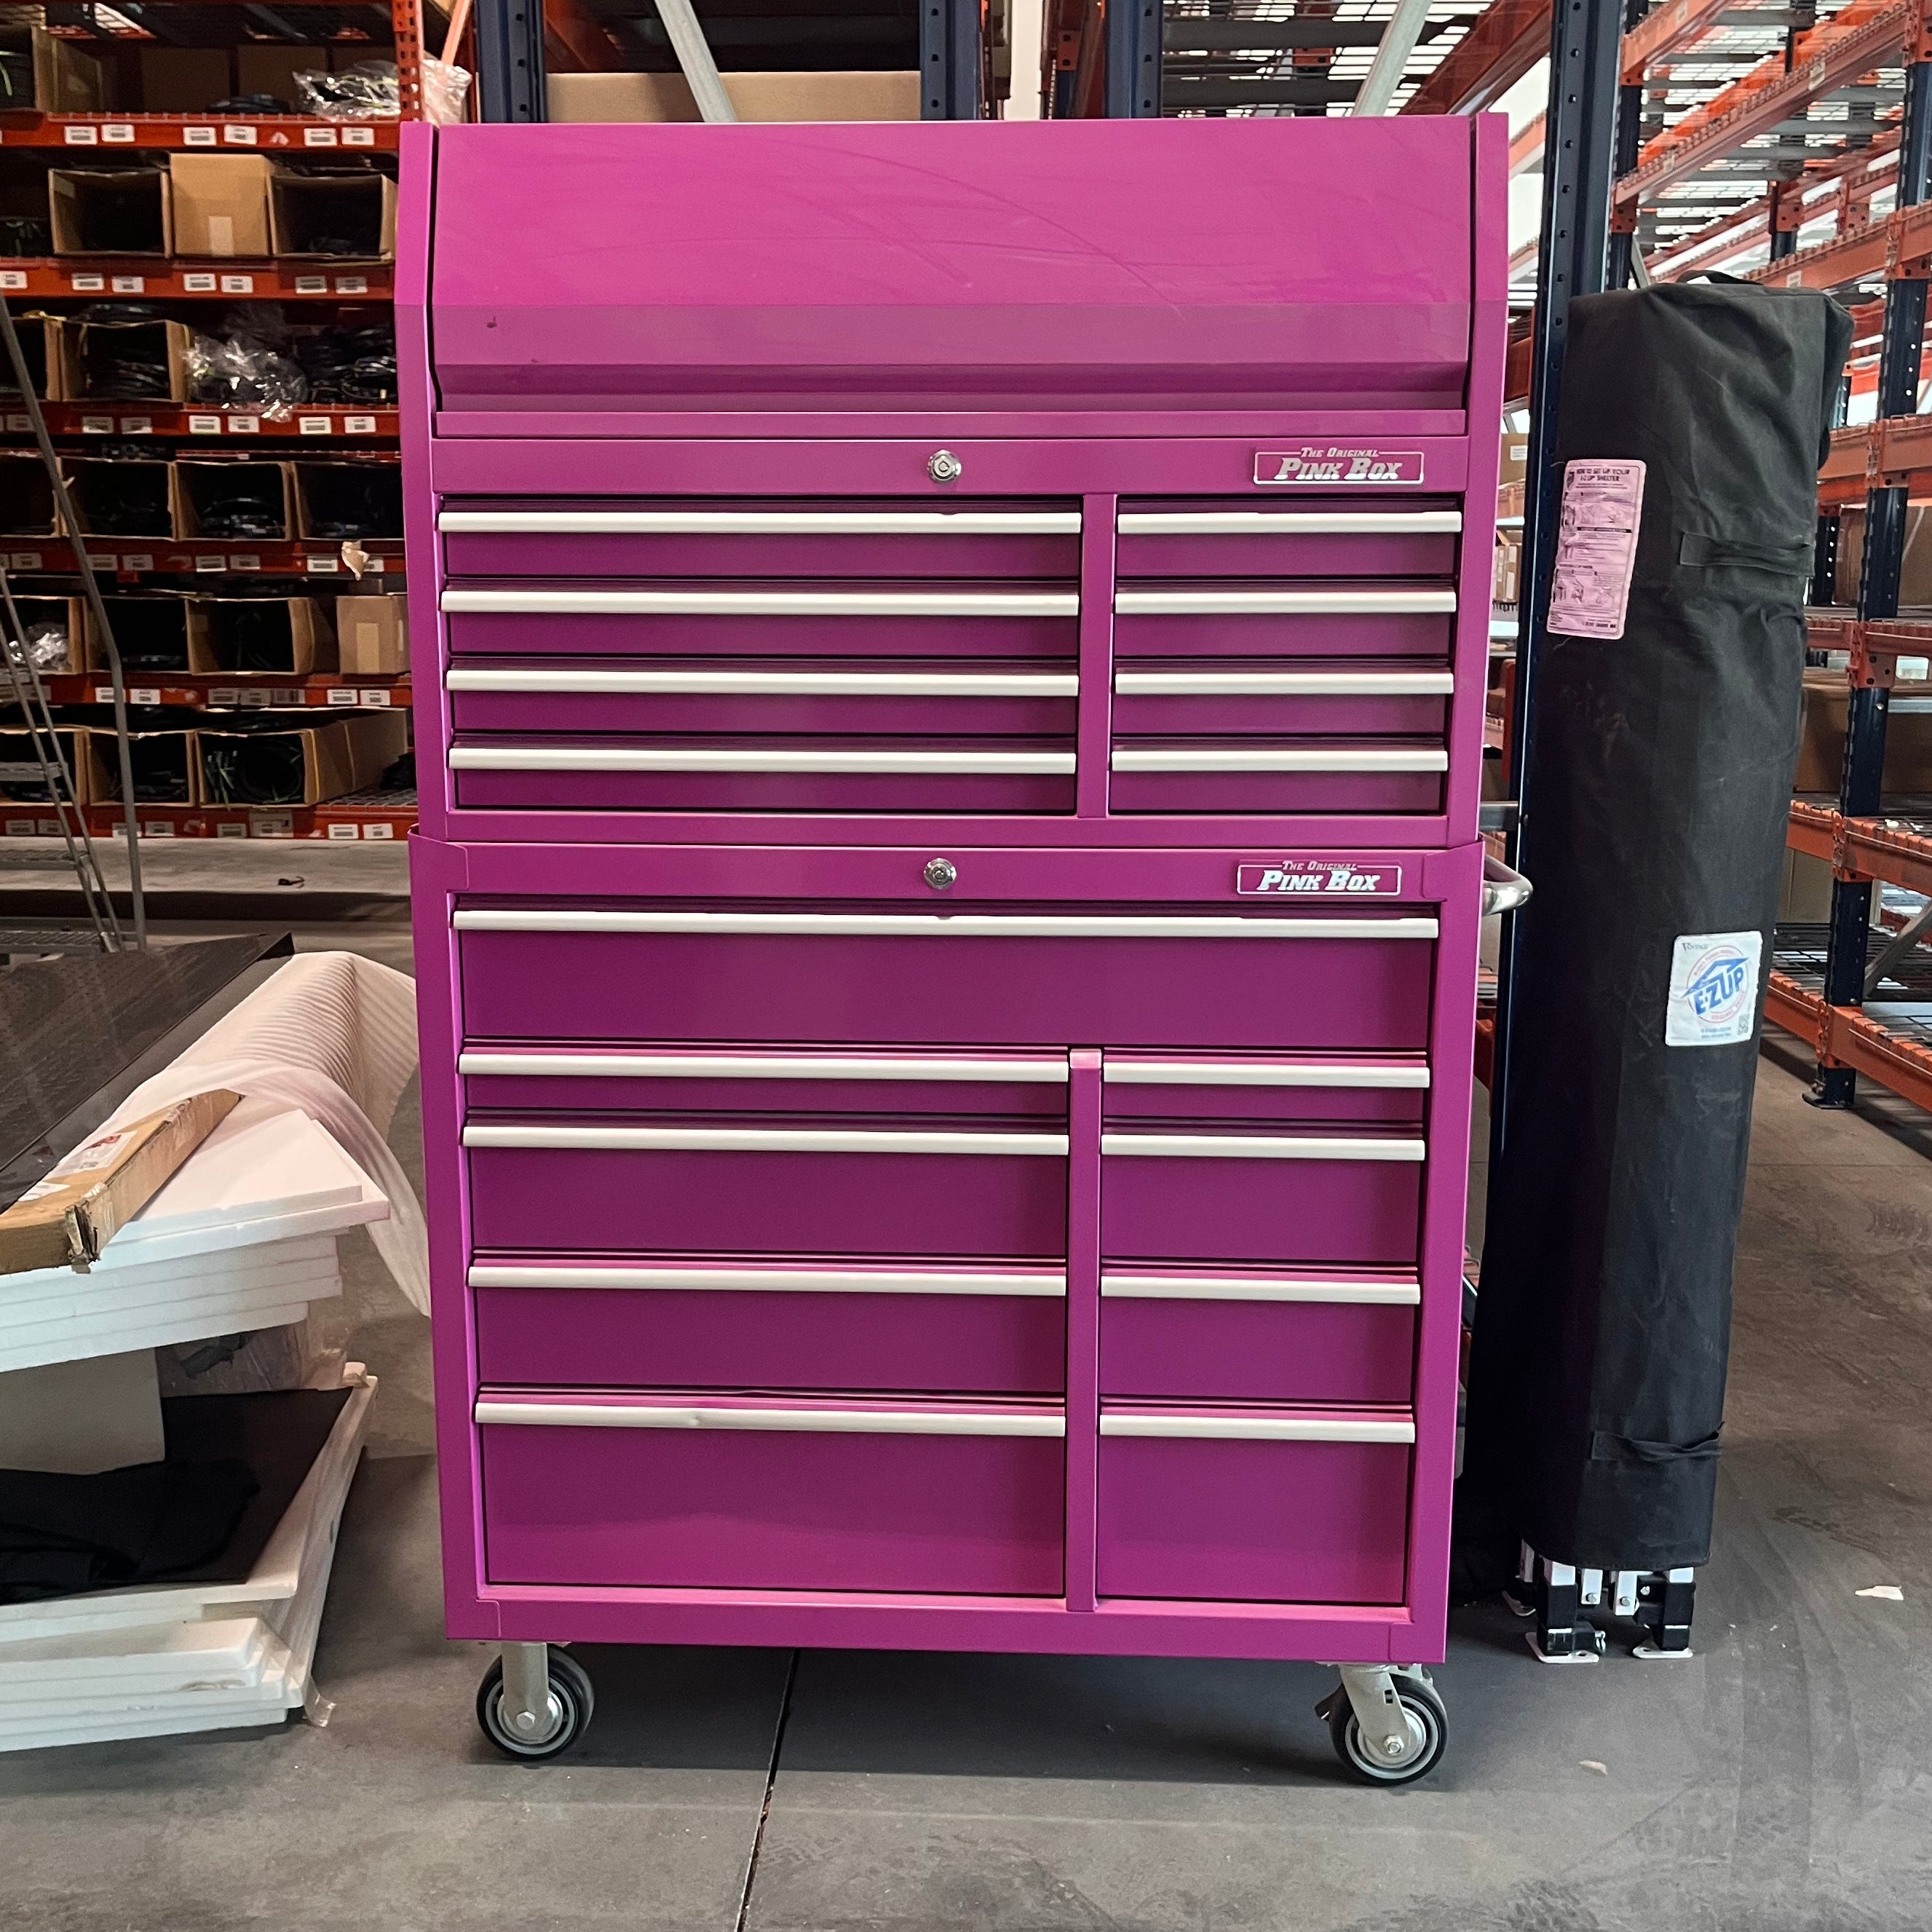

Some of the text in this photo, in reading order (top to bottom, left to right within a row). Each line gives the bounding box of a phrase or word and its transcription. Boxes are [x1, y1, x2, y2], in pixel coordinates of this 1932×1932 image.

[1301, 447, 1379, 458] THE ORIGINAL
[1274, 457, 1403, 480] PINK BOX
[1281, 860, 1305, 871] THE
[1256, 869, 1381, 891] PINK BOX
